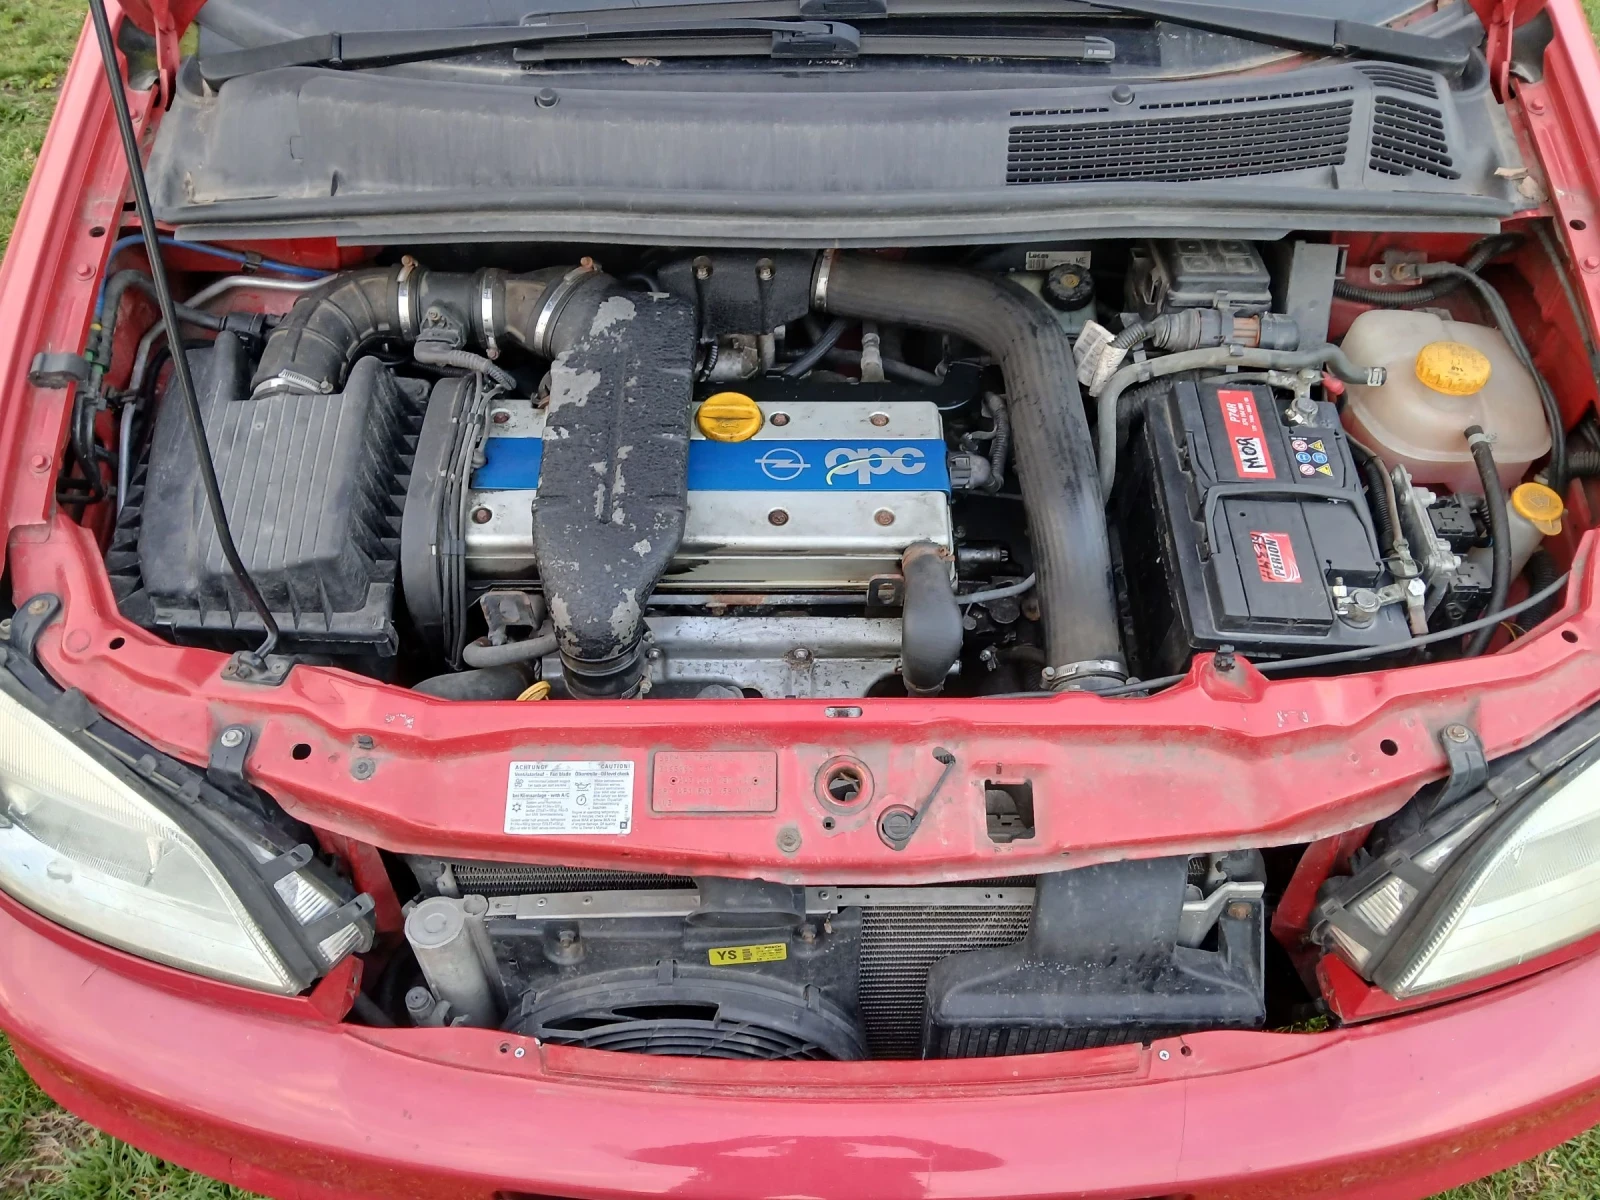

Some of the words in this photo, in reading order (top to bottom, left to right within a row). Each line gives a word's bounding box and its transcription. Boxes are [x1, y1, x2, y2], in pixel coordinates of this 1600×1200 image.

[1226, 403, 1240, 423] P74R
[824, 447, 926, 485] opc
[1266, 539, 1285, 577] PERION
[717, 950, 737, 961] YS
